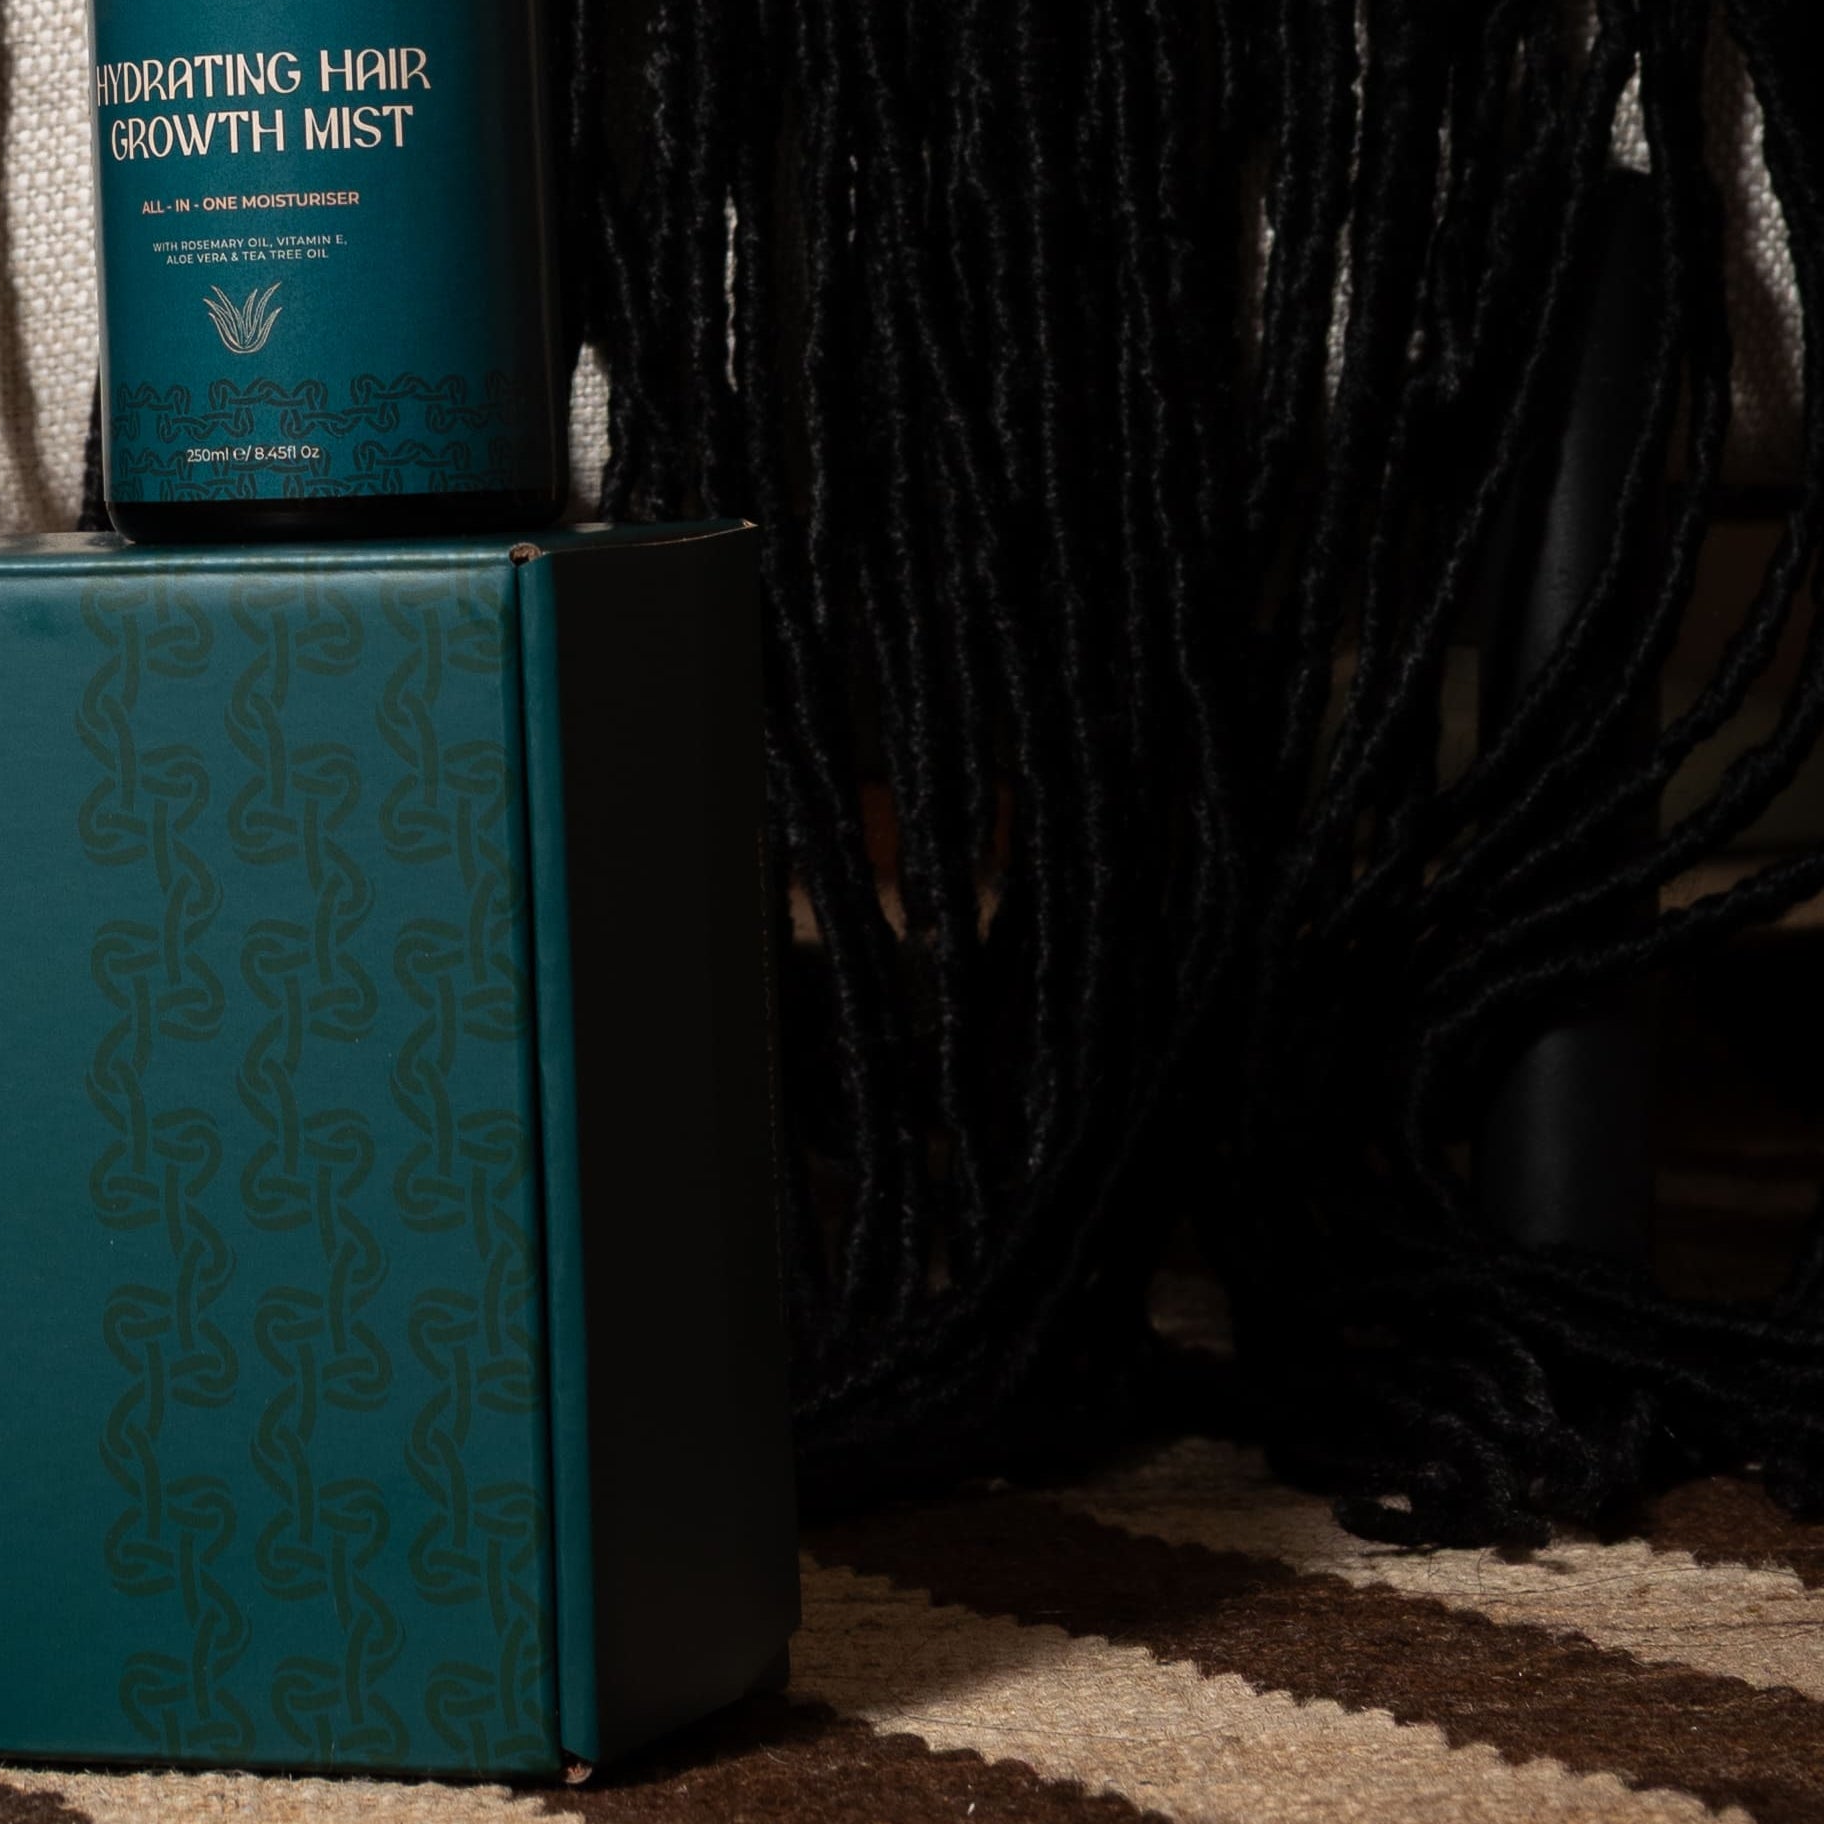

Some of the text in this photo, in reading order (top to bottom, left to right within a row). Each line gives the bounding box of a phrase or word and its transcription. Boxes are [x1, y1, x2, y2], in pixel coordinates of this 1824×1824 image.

[96, 47, 431, 107] HYDRATING HAIR
[111, 105, 413, 160] GROWTH MIST
[142, 201, 165, 214] ALL
[175, 199, 190, 212] IN
[203, 196, 238, 211] ONE
[242, 191, 360, 208] MOISTURISER
[153, 242, 178, 252] WITH
[181, 239, 244, 250] ROSEMARY
[248, 237, 273, 248] OIL,
[277, 235, 331, 247] VITAMIN
[166, 248, 329, 264] ALOE VERA & TEA TREE OIL
[186, 447, 229, 462] 250ml
[254, 445, 297, 460] 8.45fl
[300, 445, 320, 459] Oz
